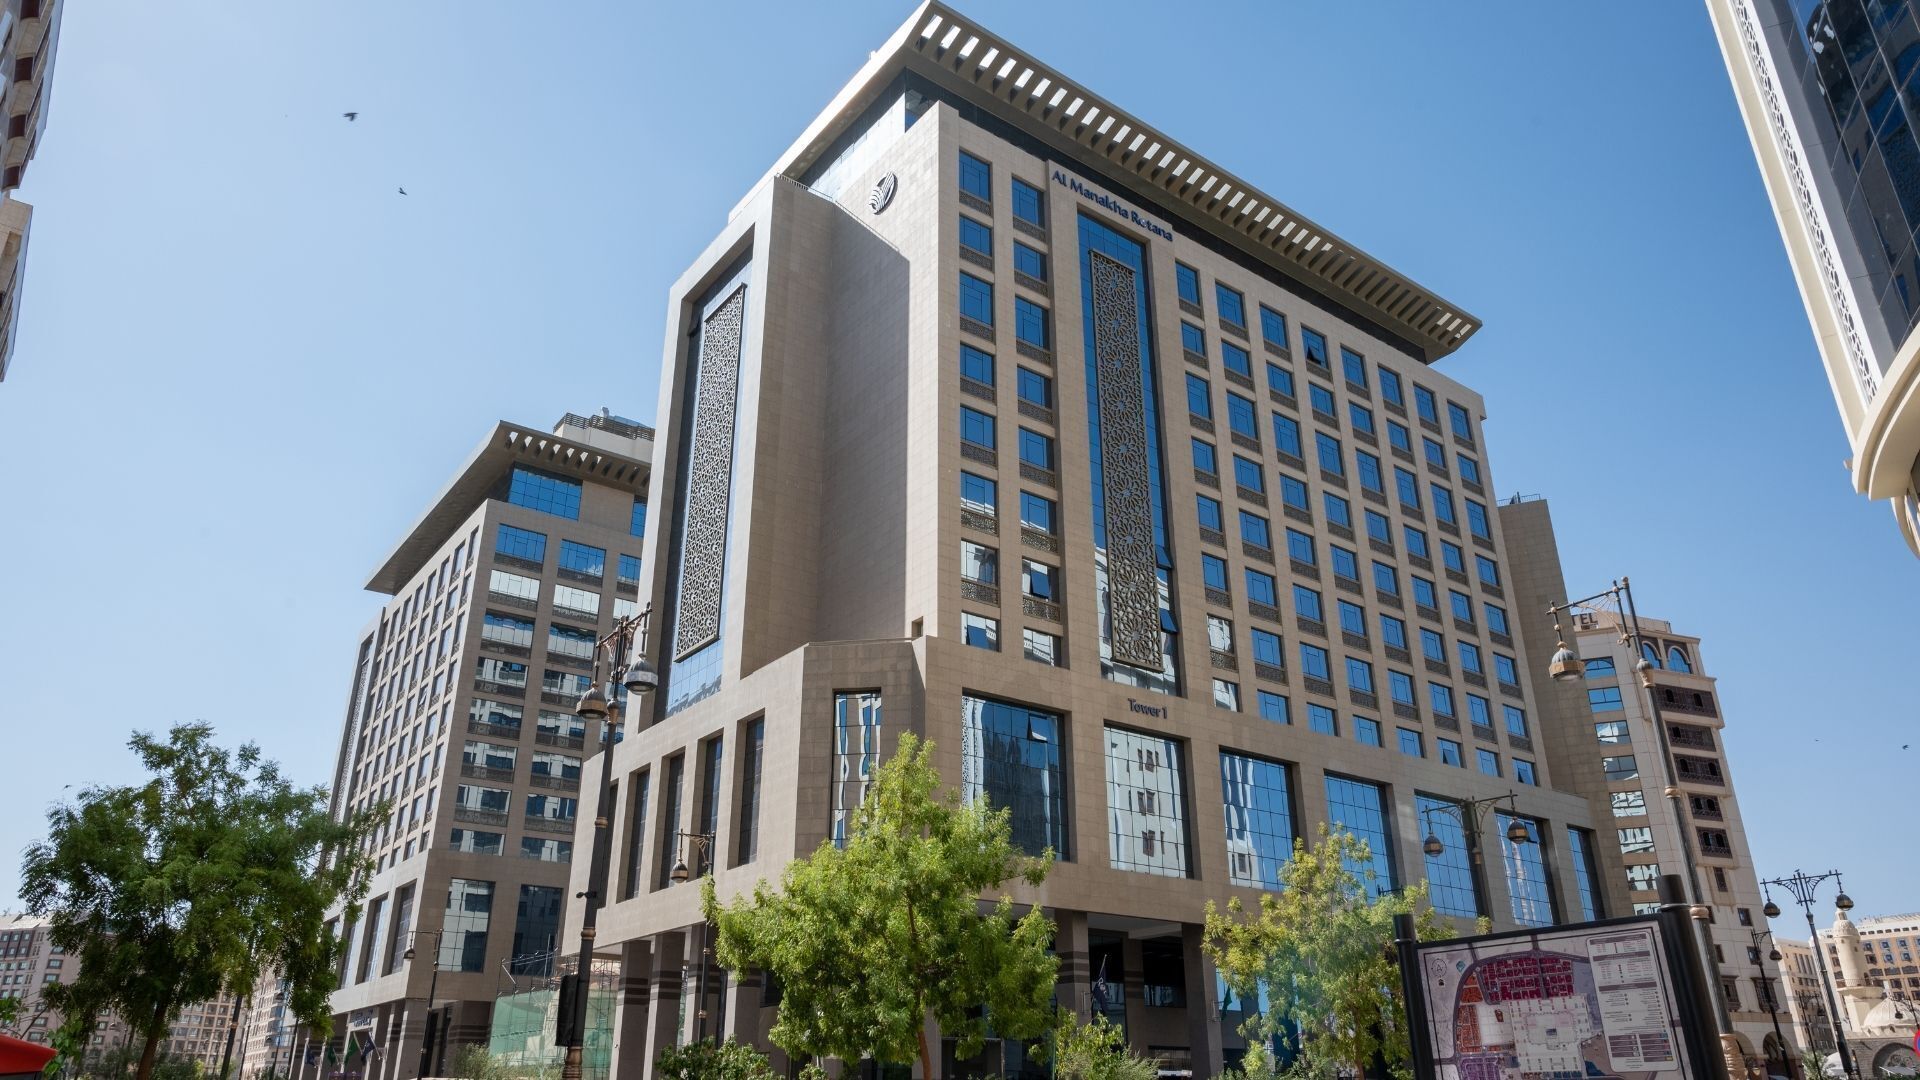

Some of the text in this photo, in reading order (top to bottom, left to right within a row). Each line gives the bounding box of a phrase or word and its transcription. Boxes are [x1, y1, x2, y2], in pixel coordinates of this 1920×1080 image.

[1052, 170, 1174, 242] Al Manakha Rotana
[1127, 697, 1168, 720] Tower 1
